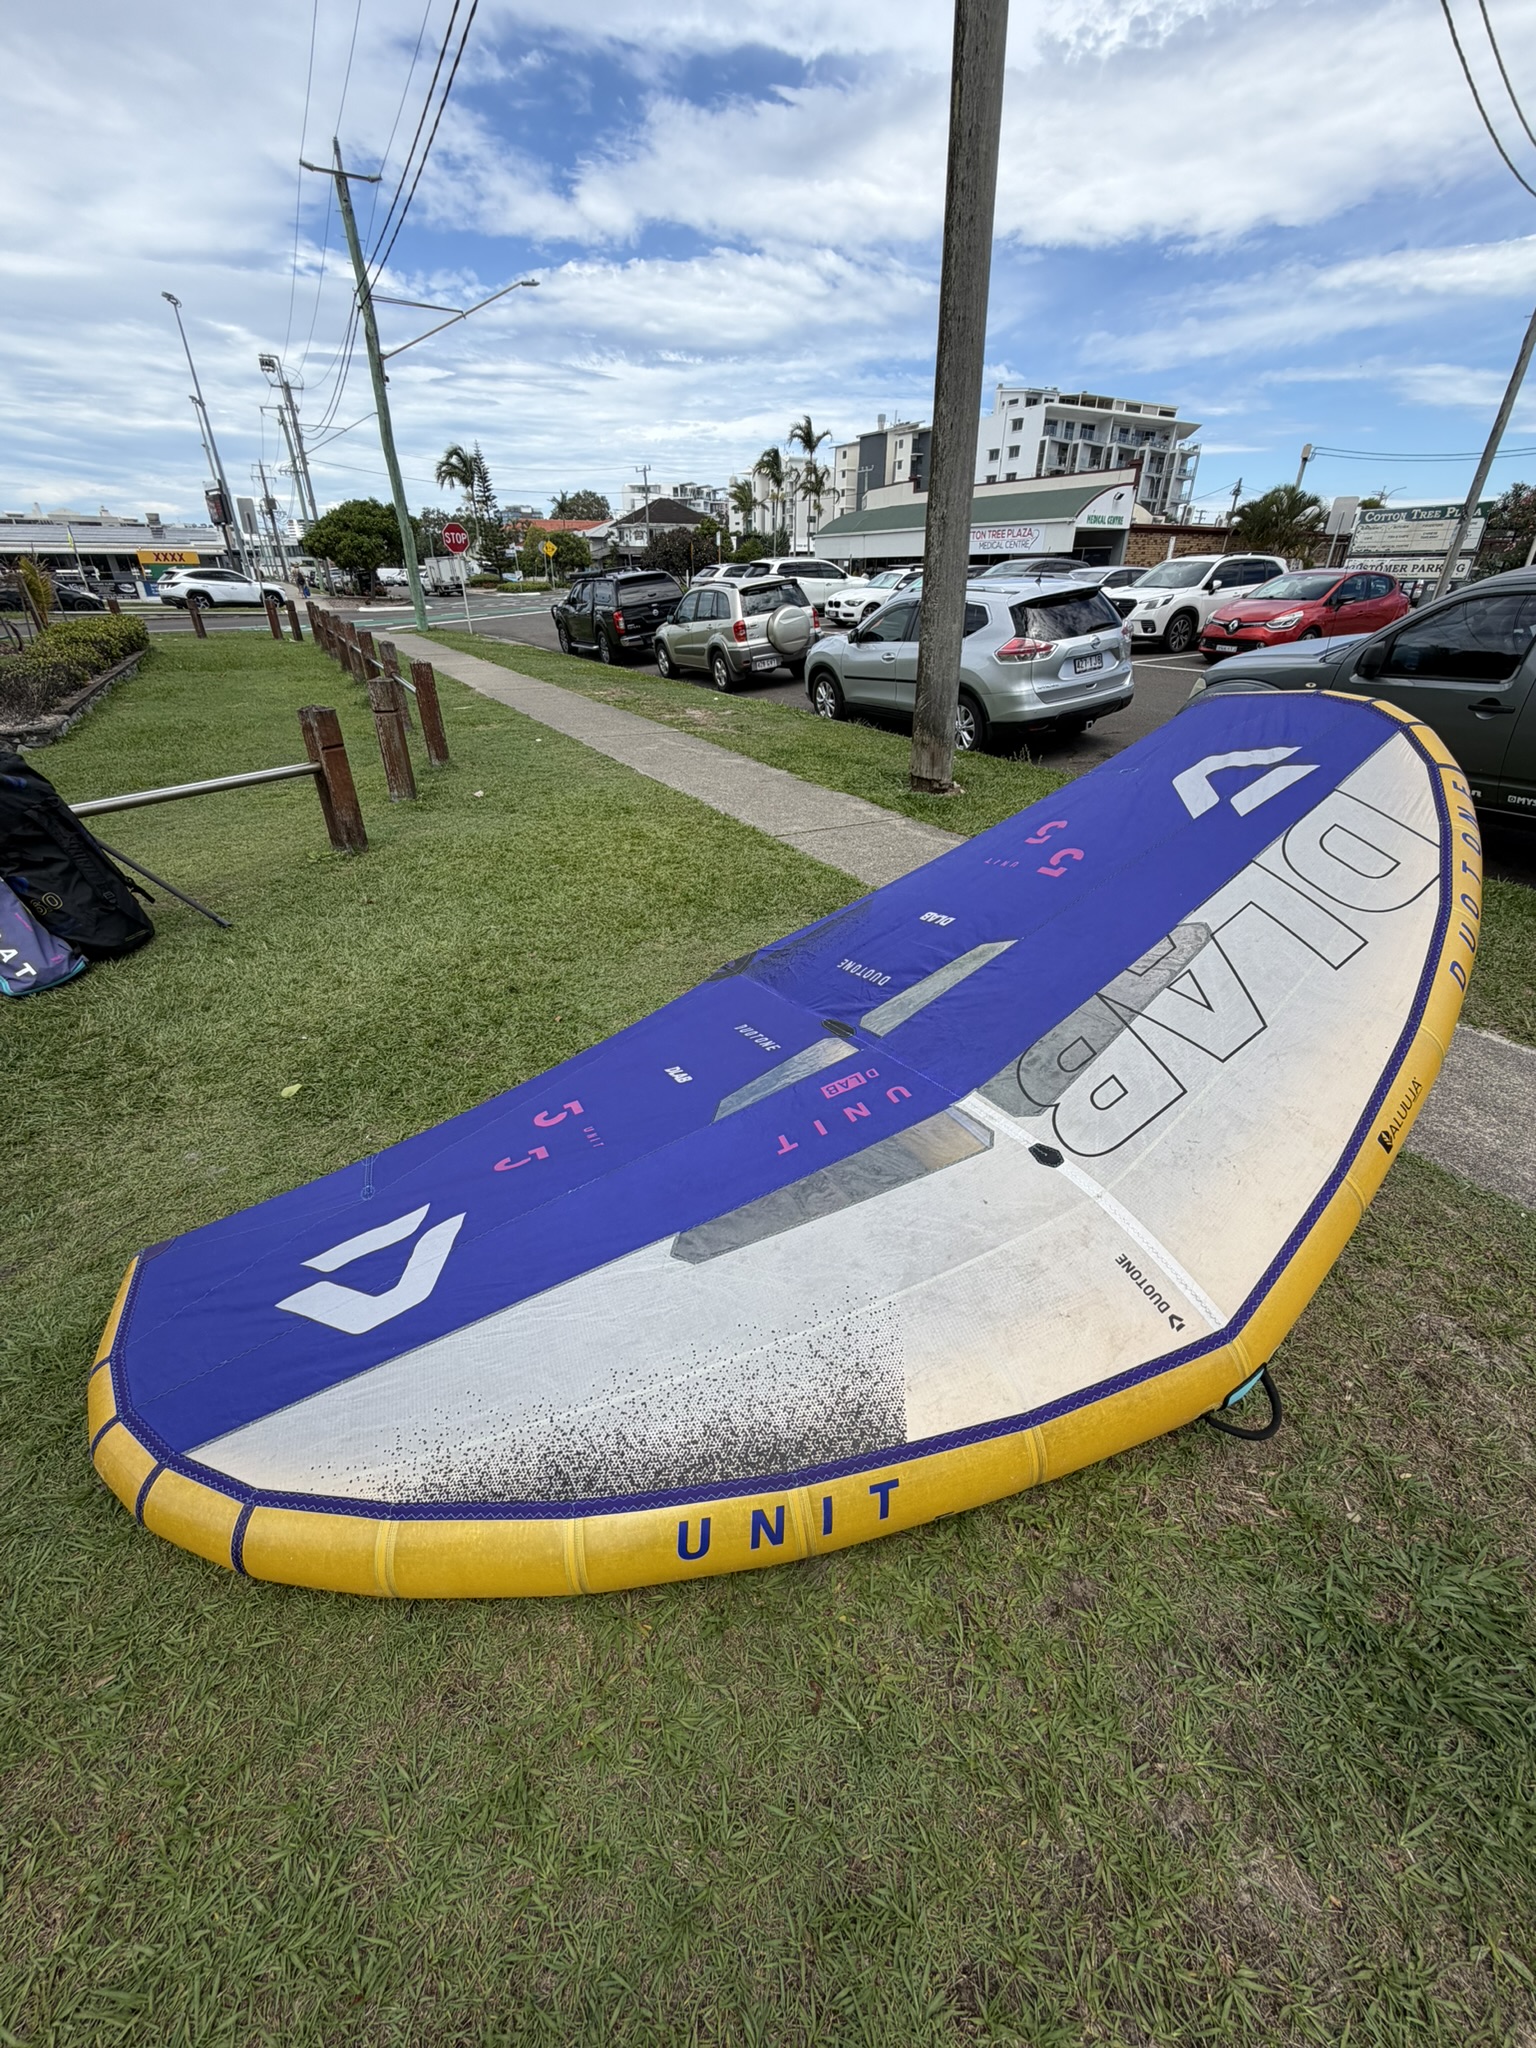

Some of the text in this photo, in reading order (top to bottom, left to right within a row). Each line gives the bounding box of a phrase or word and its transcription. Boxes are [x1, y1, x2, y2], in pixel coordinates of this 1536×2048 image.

[1086, 514, 1124, 526] MEDICAL CENTRE
[1411, 508, 1441, 520] TREE
[1444, 506, 1482, 518] PLA
[444, 532, 467, 545] STOP
[970, 527, 1033, 540] TON TREE PLAZA
[979, 539, 1030, 549] MEDICAL CENTRE
[153, 552, 186, 562] XXXX
[984, 857, 1019, 868] UNIT
[1449, 780, 1481, 993] DUOTONE
[919, 911, 957, 927] DLAB
[836, 958, 892, 987] DUOTONE
[734, 1023, 781, 1051] DUOTONE
[664, 1066, 693, 1083] DLAB
[777, 1085, 913, 1156] UNIT
[583, 1126, 604, 1148] UNIT
[1114, 1253, 1171, 1314] DUOTONE
[677, 1478, 900, 1561] UNIT
